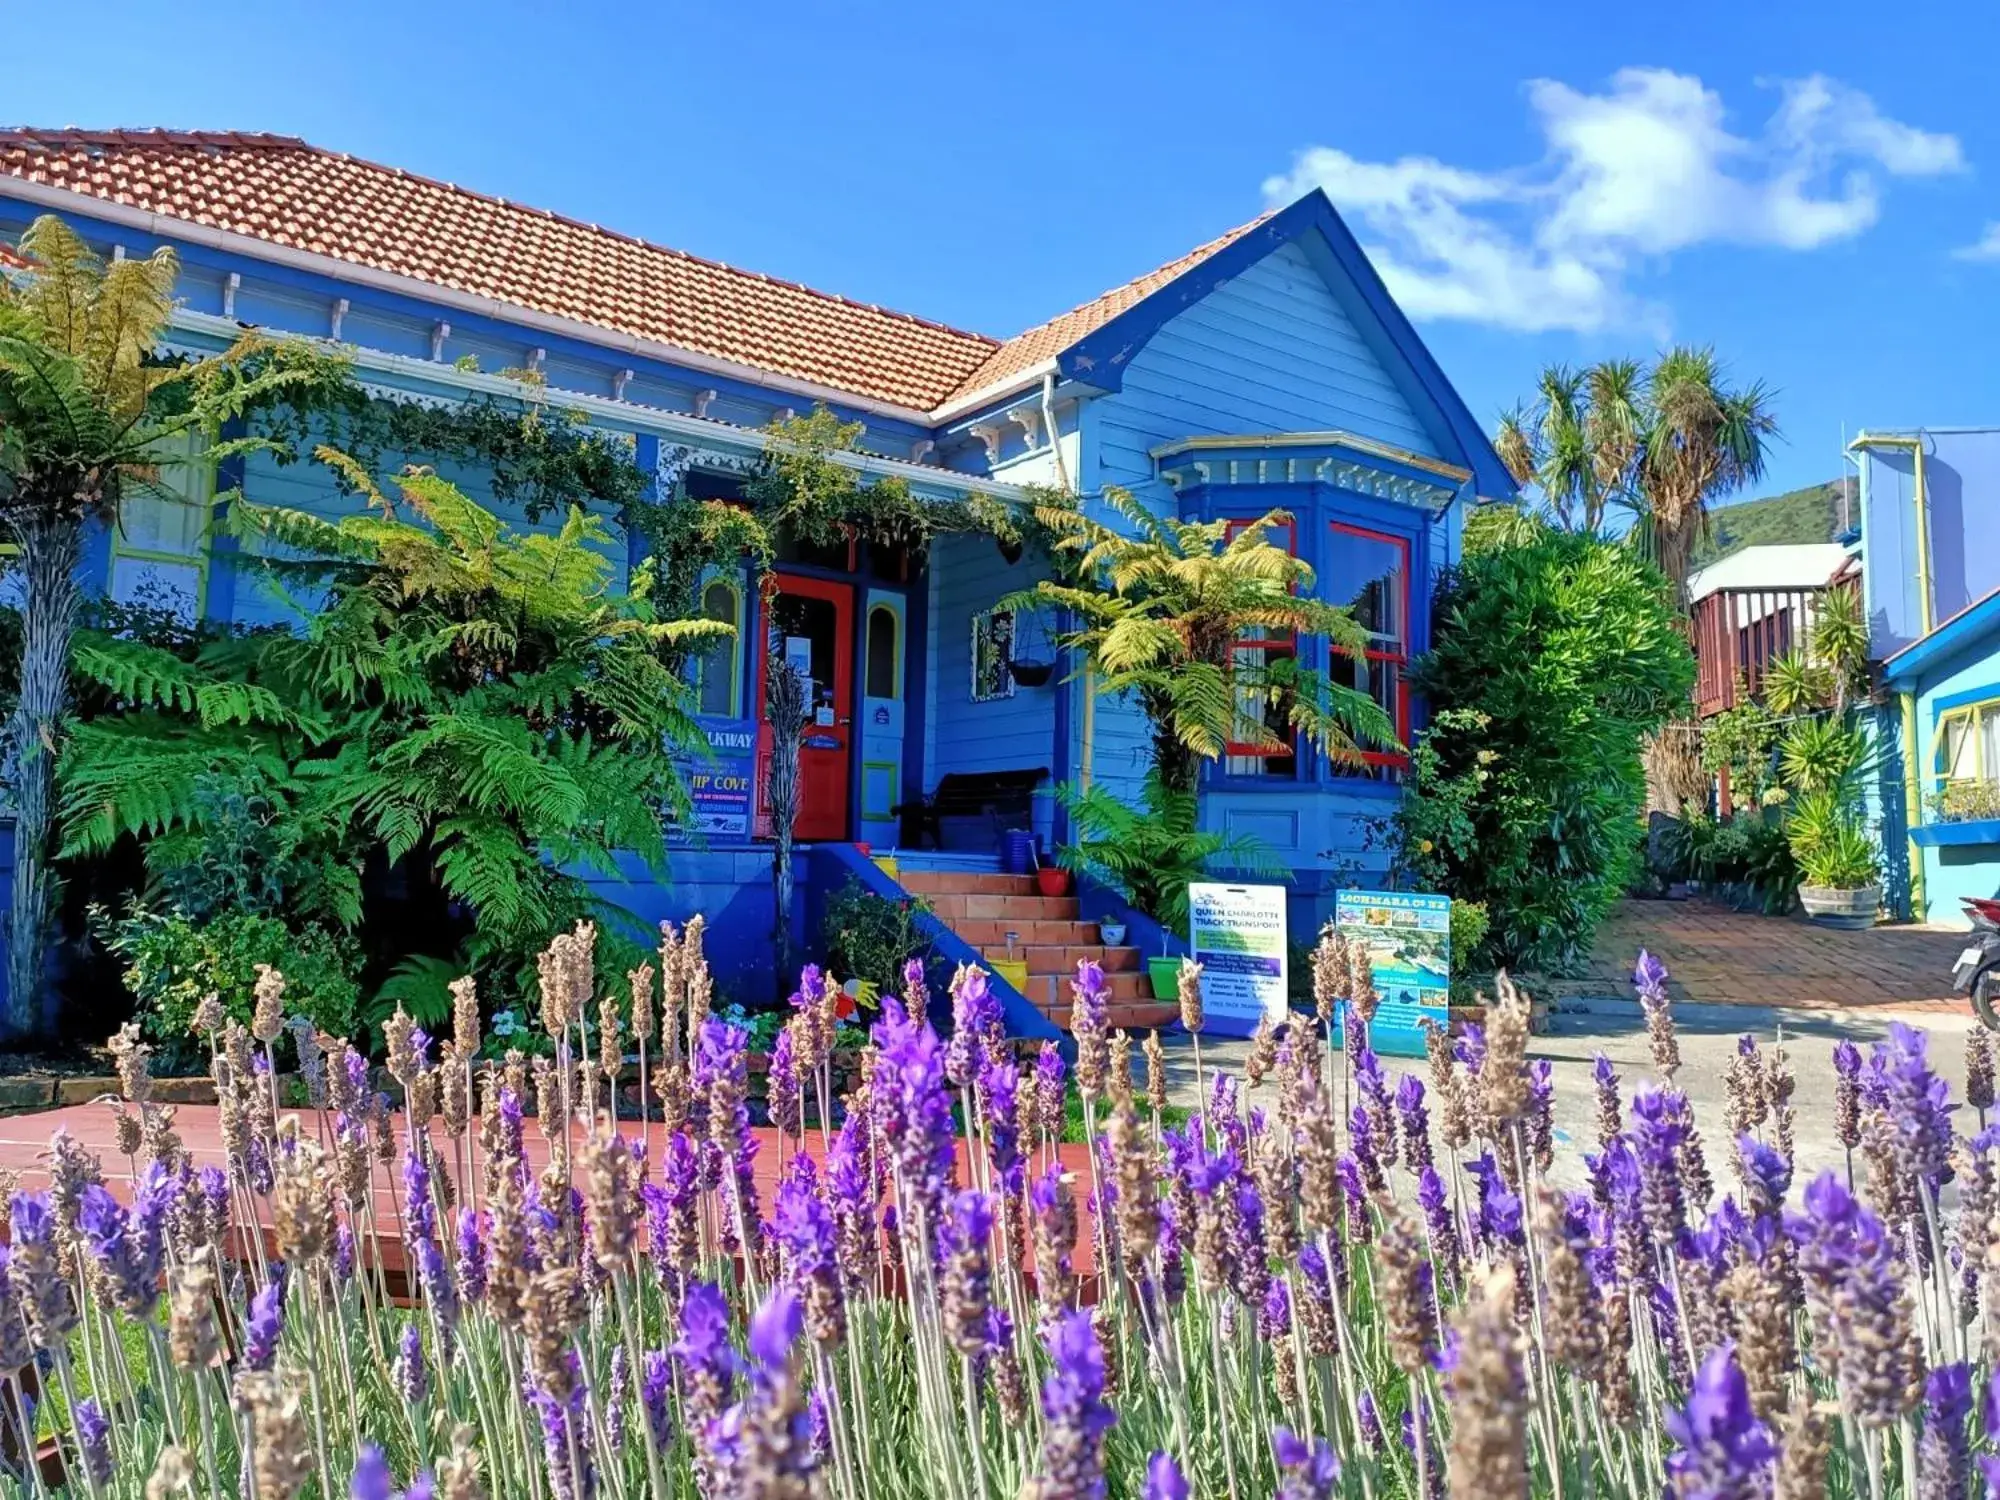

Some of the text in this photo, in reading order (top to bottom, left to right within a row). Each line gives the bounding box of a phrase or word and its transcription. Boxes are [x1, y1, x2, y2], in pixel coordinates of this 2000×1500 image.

[707, 731, 754, 748] LKWAY
[713, 776, 750, 791] COVE
[1195, 907, 1279, 919] QUEEN CHARLOTTE
[1194, 917, 1280, 929] TRACK TRANSPORT
